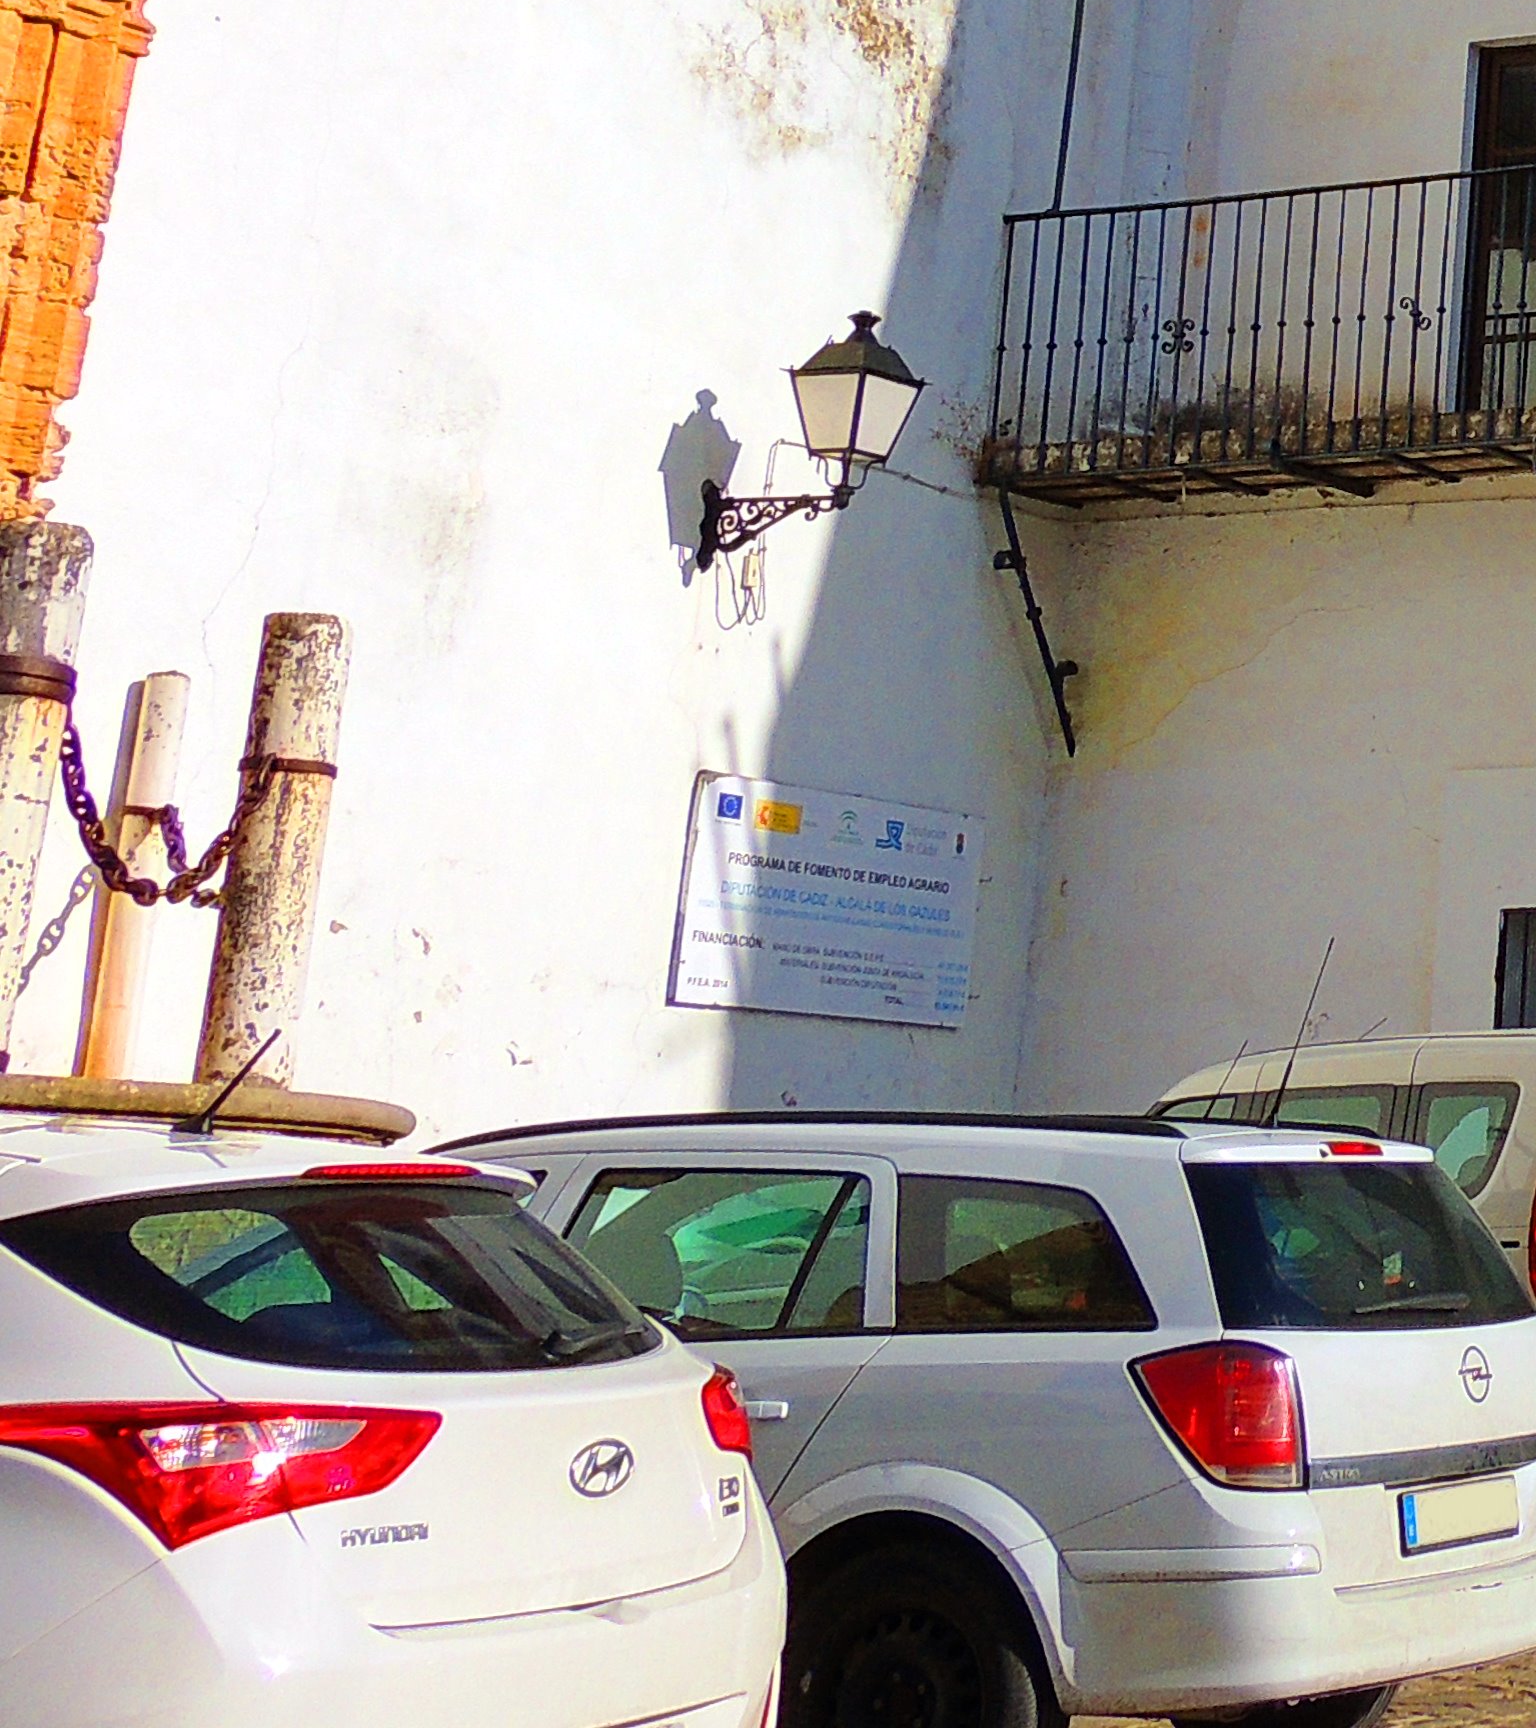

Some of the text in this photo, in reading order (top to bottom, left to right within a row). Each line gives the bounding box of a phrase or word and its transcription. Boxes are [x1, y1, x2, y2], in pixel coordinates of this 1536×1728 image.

[728, 851, 950, 894] PROGRAMA DE FOMENTO DE EMPLEO AGRARIO
[1320, 1467, 1360, 1482] ASTRA
[340, 1522, 429, 1548] HYUNDAI
